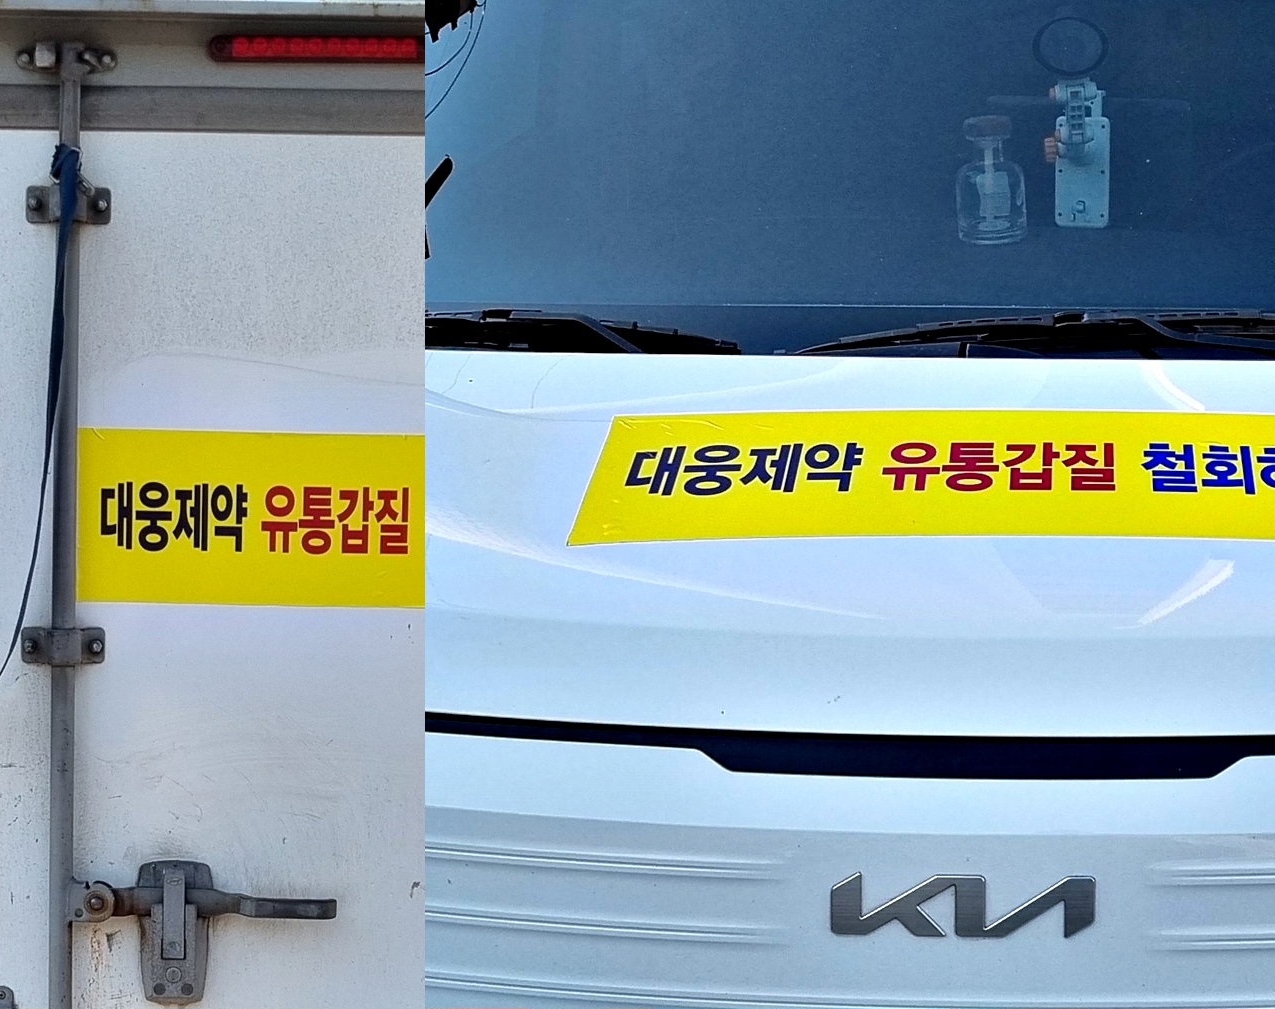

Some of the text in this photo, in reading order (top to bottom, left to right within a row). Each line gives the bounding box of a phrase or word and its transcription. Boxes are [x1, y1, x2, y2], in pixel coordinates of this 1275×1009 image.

[624, 442, 863, 496] 대웅제약
[881, 442, 1116, 492] 유통갑질
[101, 482, 409, 554] 대웅제약 유통갑질
